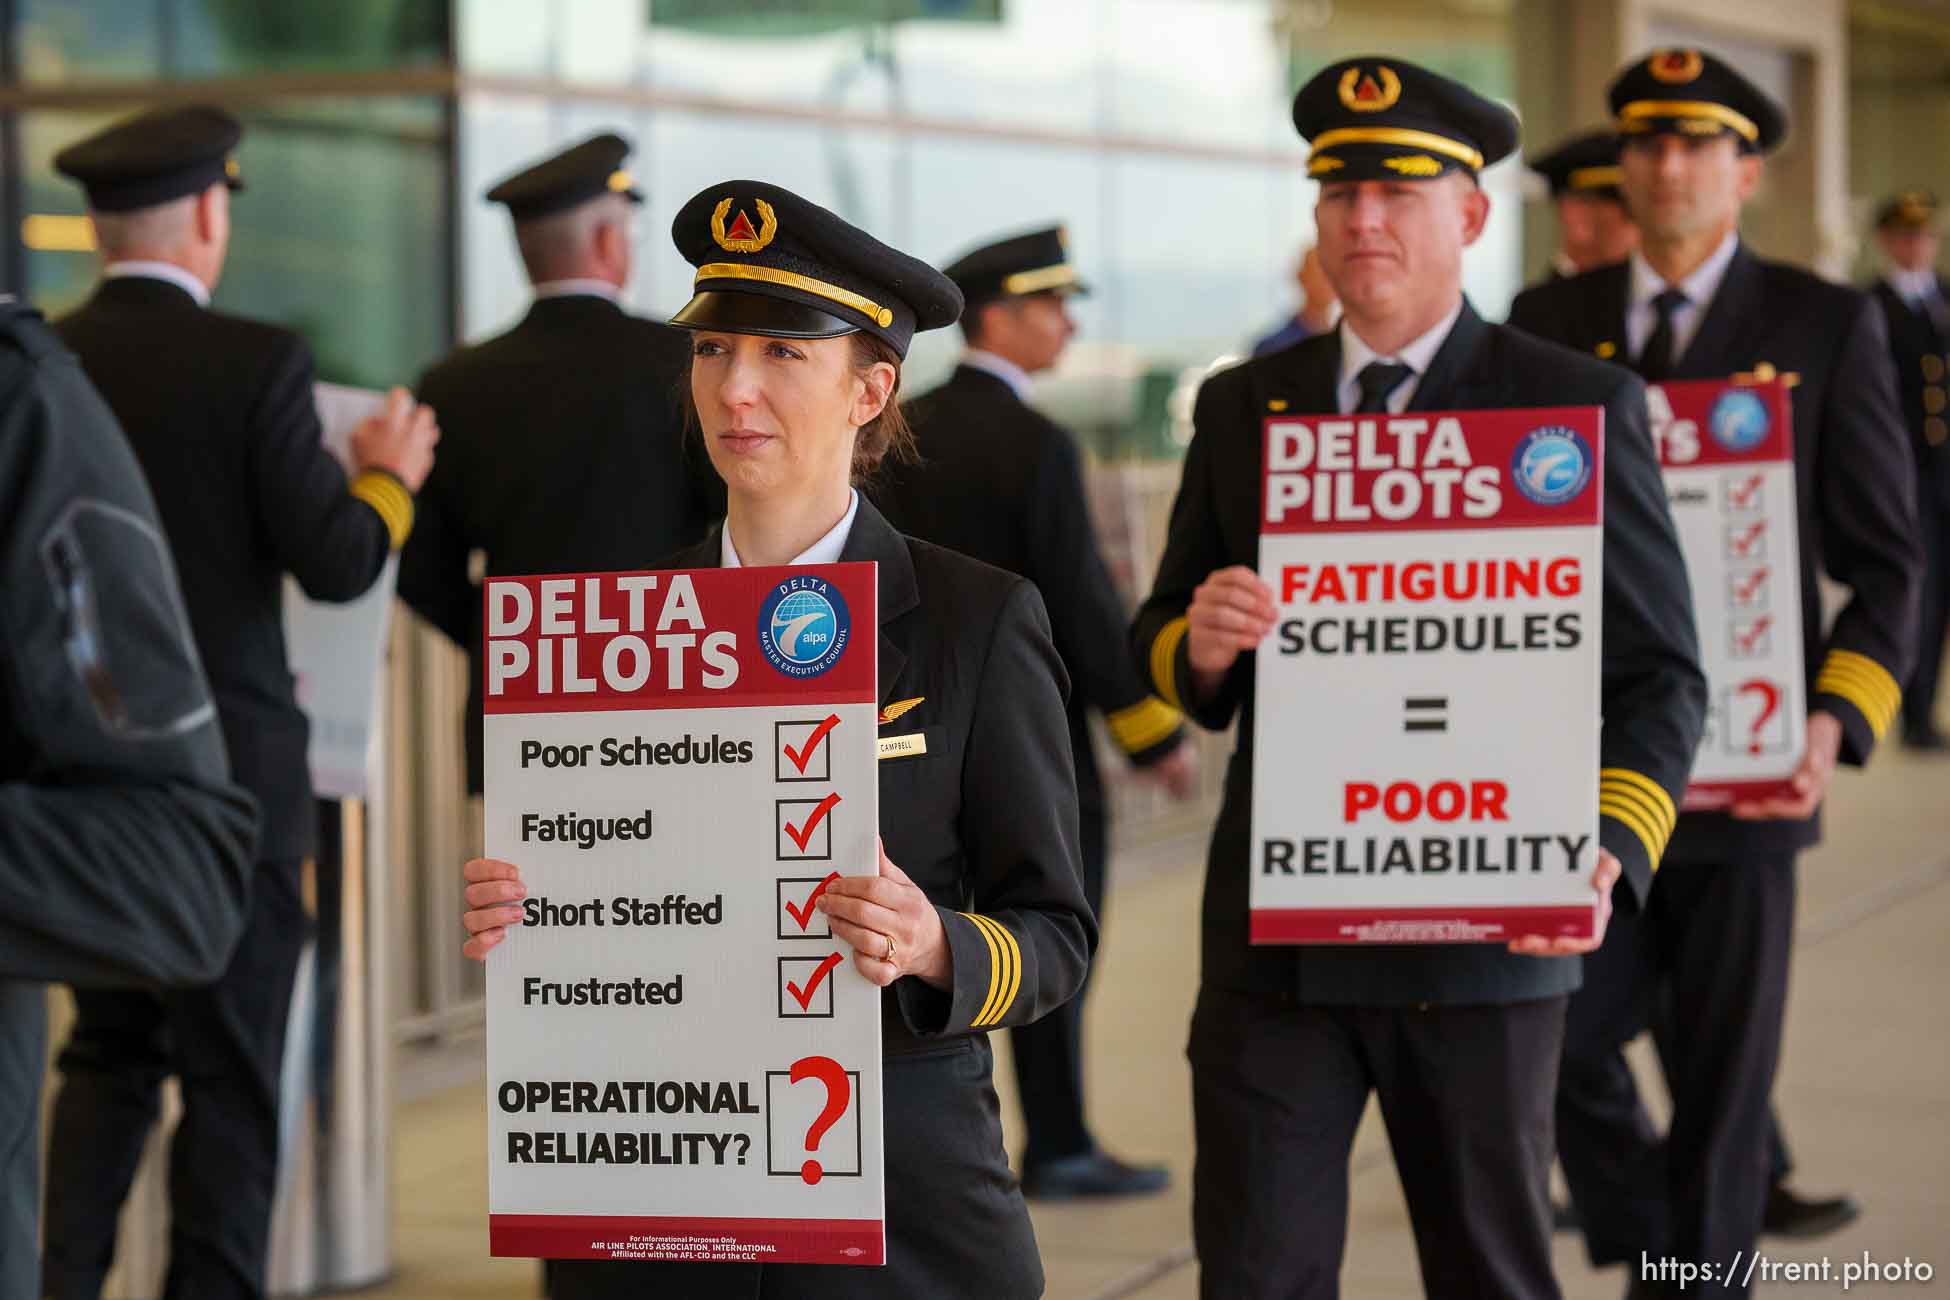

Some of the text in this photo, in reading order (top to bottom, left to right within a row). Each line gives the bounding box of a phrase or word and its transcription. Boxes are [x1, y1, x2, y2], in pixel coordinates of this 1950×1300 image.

[1267, 417, 1472, 471] DELTA
[1265, 466, 1502, 523] PILOTS
[780, 577, 828, 595] DELTA
[1280, 557, 1582, 604] FATIGUING
[488, 574, 706, 637] DELTA
[761, 628, 847, 675] MASTER EXECUTIVE COUNCIL
[802, 632, 827, 646] alpa
[1279, 613, 1583, 656] SCHEDULES
[488, 631, 739, 696] PILOTS
[521, 734, 753, 768] Poor Schedules
[880, 741, 912, 753] CAMPBELL
[1343, 779, 1509, 824] POOR
[521, 810, 652, 849] Fatigued
[1262, 834, 1590, 875] RELIABILITY
[522, 895, 723, 926] Short Staffed
[523, 975, 683, 1005] Frustrated
[498, 1080, 760, 1114] OPERATIONAL
[789, 1055, 851, 1186] ?
[508, 1132, 751, 1165] RELIABILITY?
[591, 1242, 605, 1250] AIR
[712, 1244, 776, 1253] INTERNATIONAL
[629, 1235, 737, 1245] For Informational Purposes Only
[665, 1251, 678, 1259] the
[727, 1252, 741, 1260] the
[742, 1252, 757, 1260] CLC
